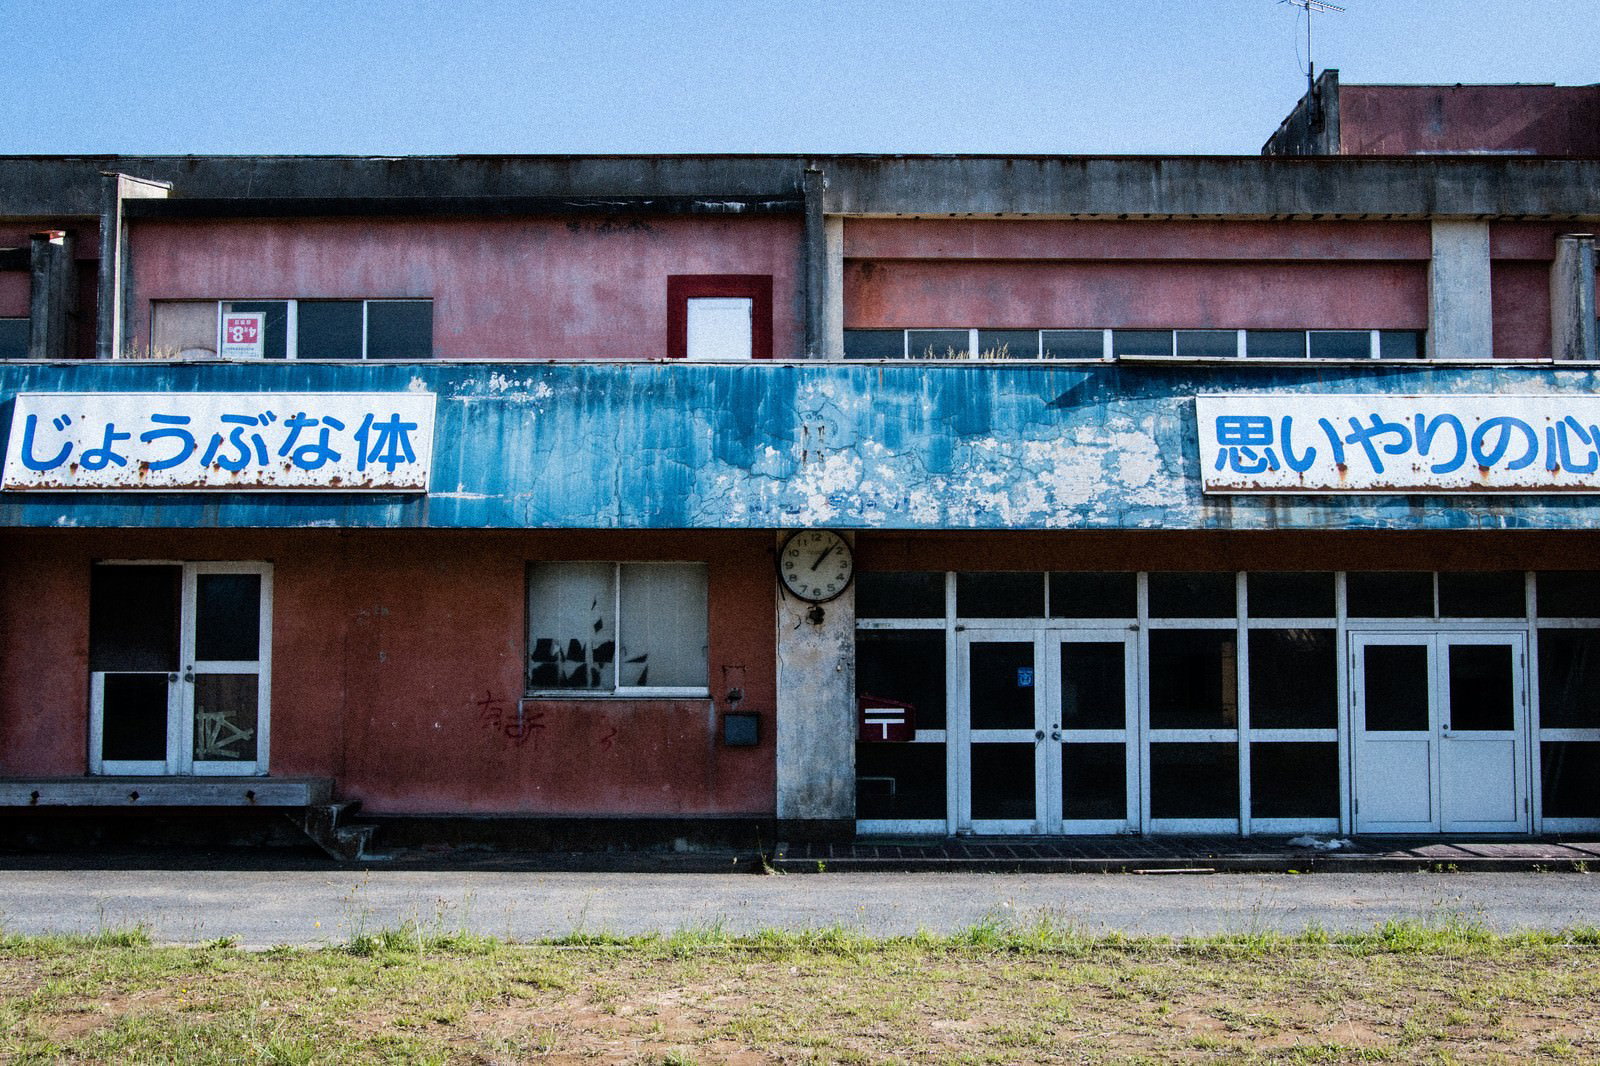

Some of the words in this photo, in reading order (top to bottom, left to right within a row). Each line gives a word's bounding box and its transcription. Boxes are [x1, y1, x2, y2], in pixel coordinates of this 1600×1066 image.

[21, 410, 418, 472] じょうぶな体
[1215, 412, 1600, 475] 思いやりの心
[811, 533, 821, 541] 12
[788, 549, 799, 557] 10
[835, 546, 843, 555] 2
[785, 561, 794, 570] 9
[840, 560, 848, 569] 3
[789, 574, 797, 582] 8
[799, 584, 808, 593] 7
[813, 588, 821, 596] 6
[827, 584, 836, 592] 5
